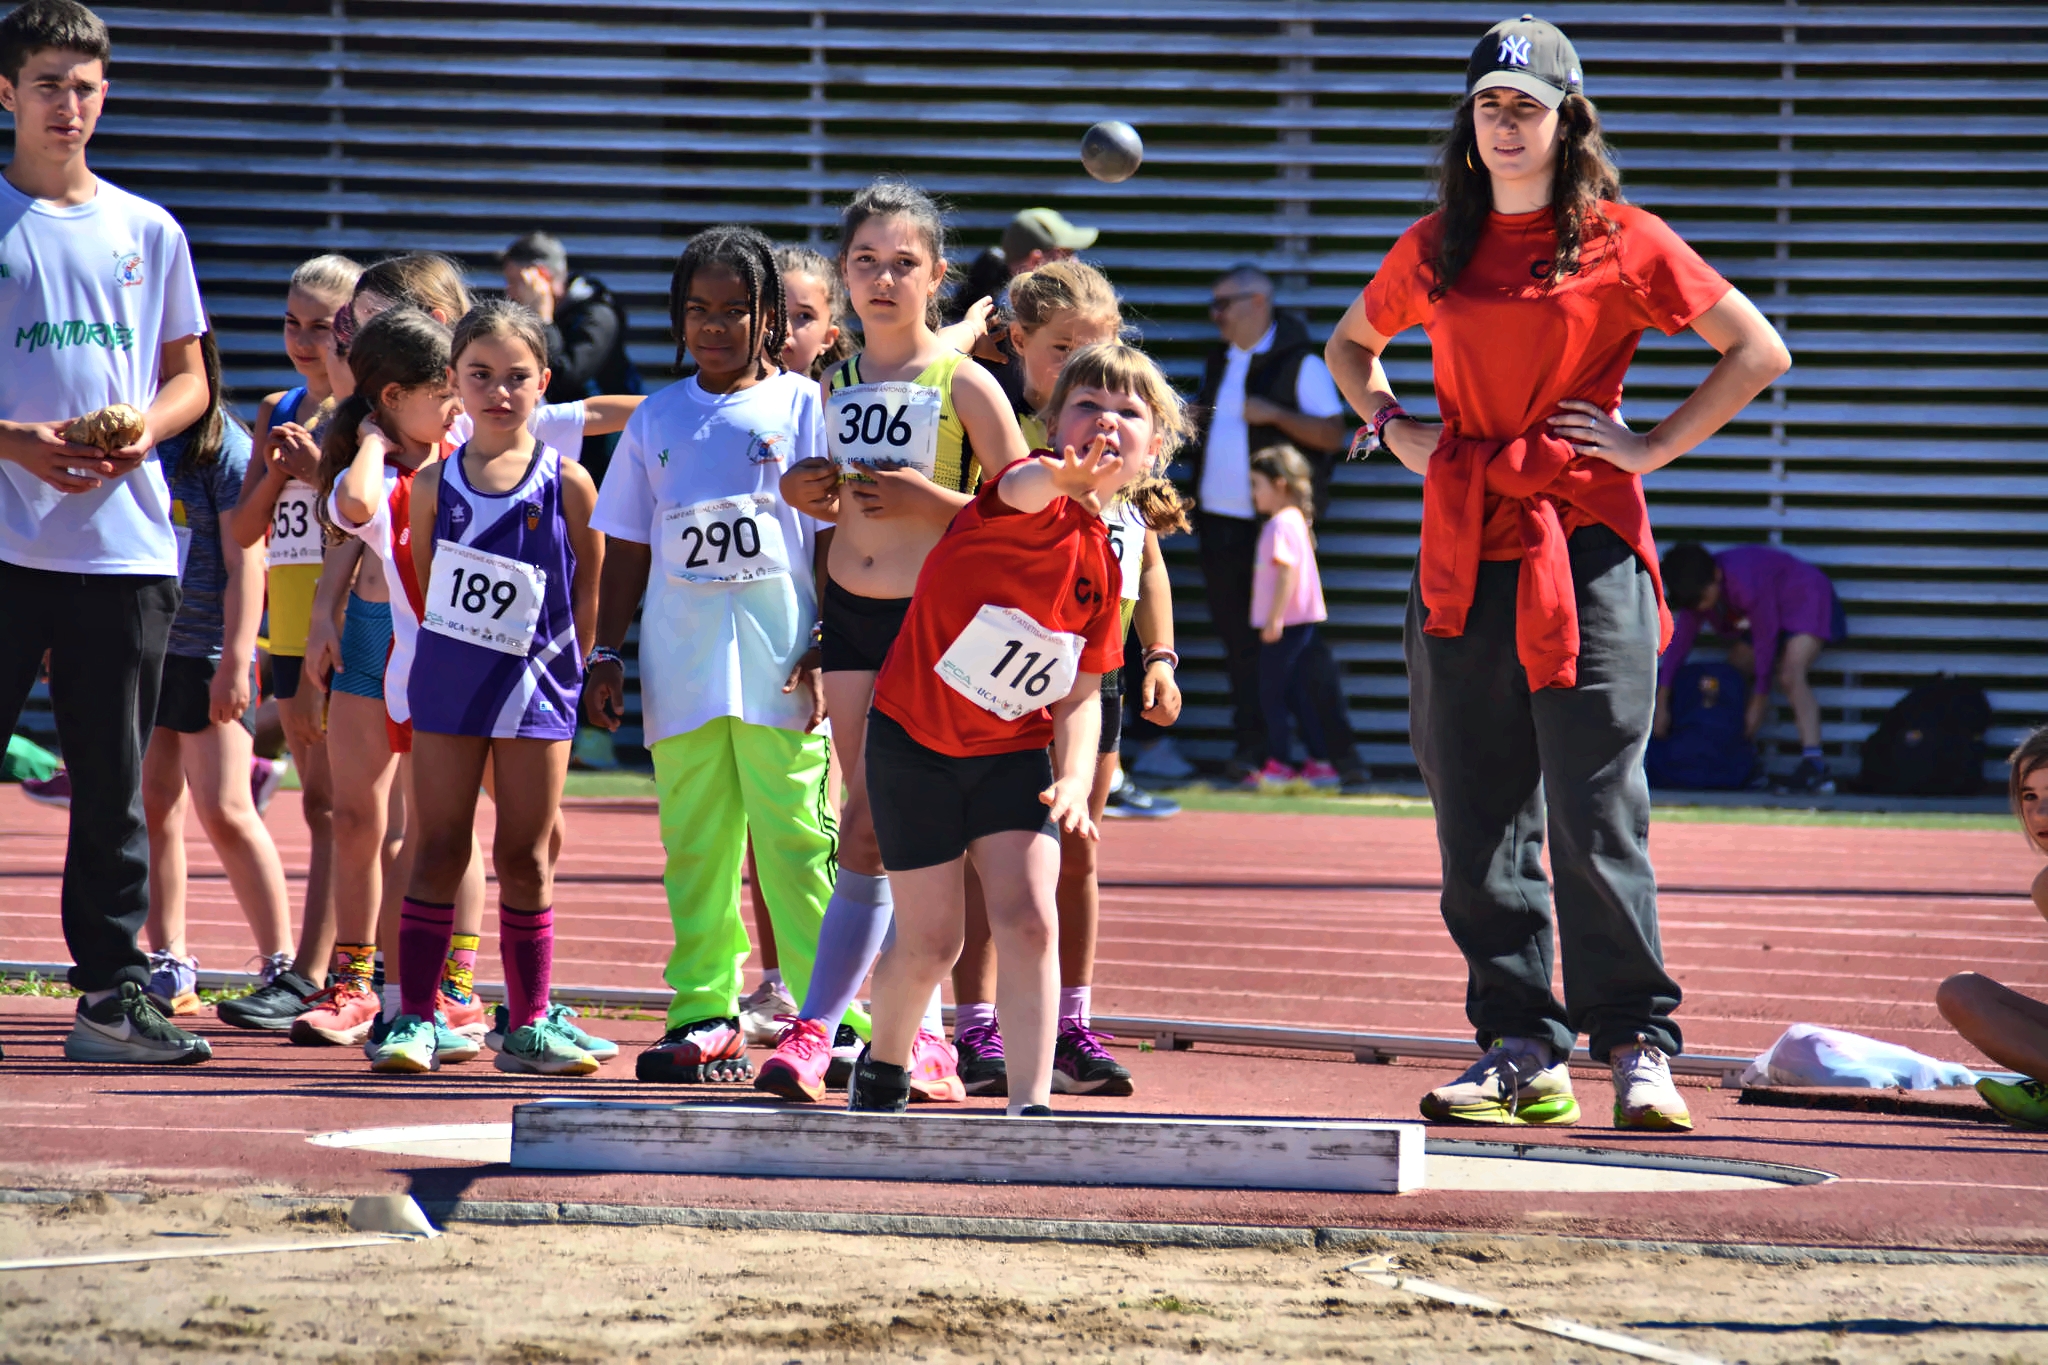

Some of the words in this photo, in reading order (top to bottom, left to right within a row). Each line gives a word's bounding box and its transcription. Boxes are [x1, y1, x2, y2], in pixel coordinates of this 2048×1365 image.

[1498, 35, 1532, 65] NY
[839, 403, 912, 446] 306
[272, 500, 308, 539] 53
[682, 517, 760, 569] 290
[450, 568, 517, 620] 189
[990, 640, 1059, 697] 116
